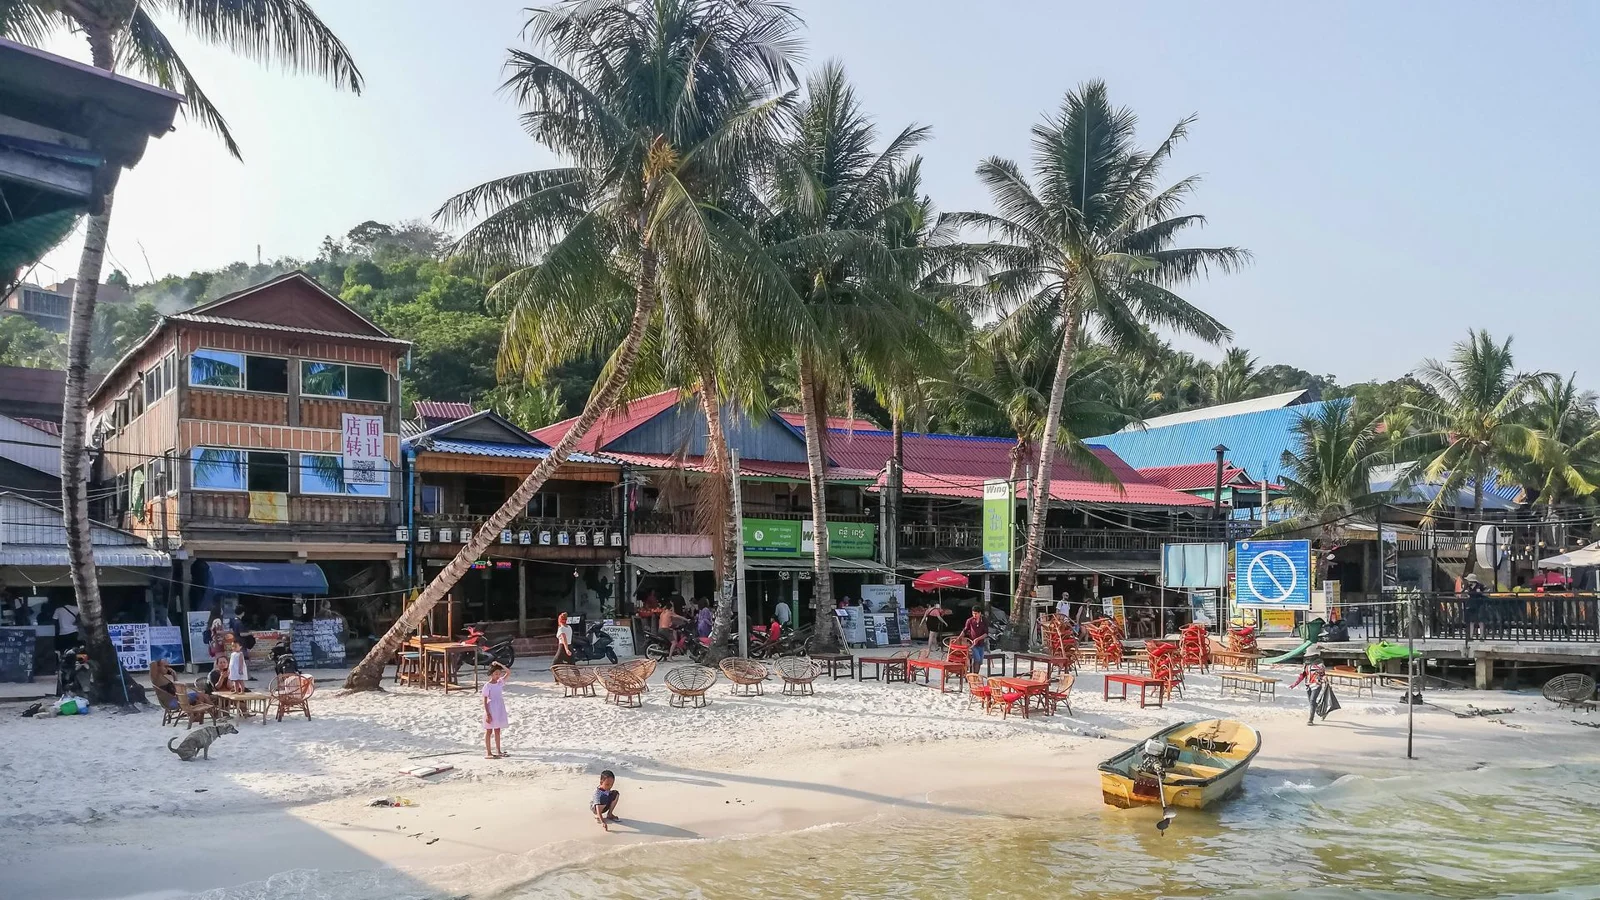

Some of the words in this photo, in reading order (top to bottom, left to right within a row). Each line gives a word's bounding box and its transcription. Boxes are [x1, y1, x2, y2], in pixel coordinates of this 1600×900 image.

[346, 416, 381, 437] 店面
[346, 436, 381, 458] 转让
[986, 485, 1007, 497] Wing
[401, 530, 471, 541] HELP
[580, 535, 621, 545] BAR
[121, 656, 136, 665] FO!
